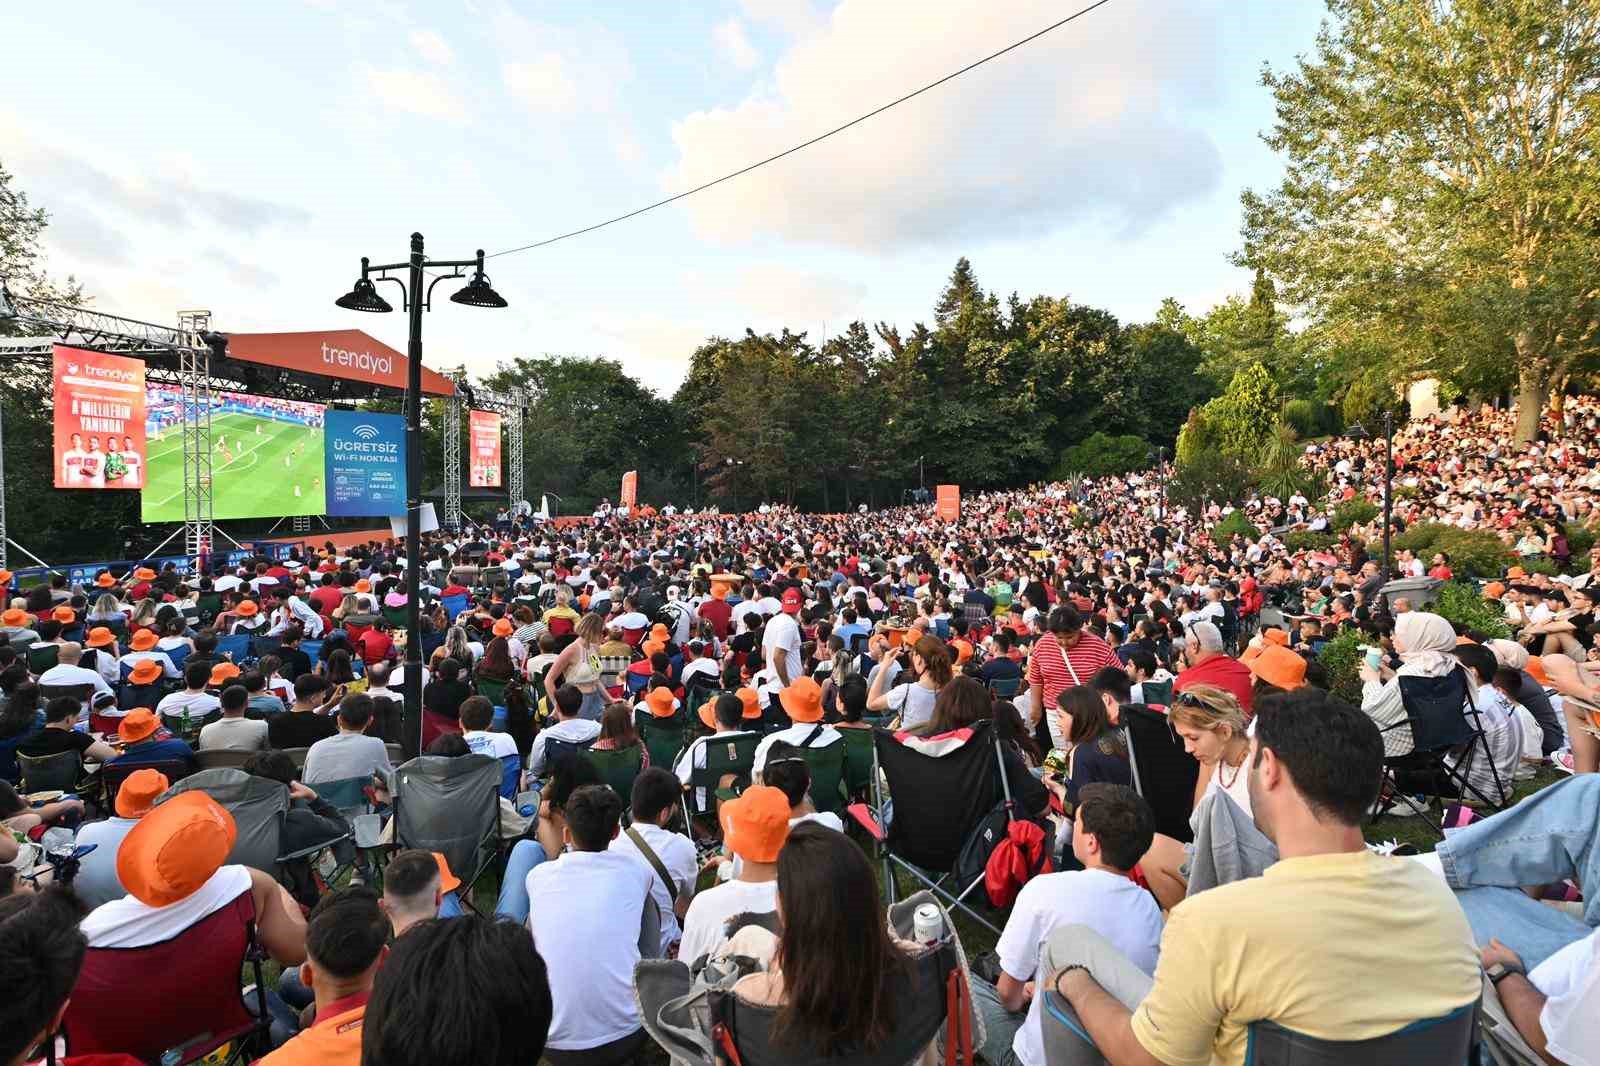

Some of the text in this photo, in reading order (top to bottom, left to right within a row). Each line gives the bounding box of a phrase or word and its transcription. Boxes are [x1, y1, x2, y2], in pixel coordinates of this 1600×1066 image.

[321, 342, 392, 375] trendyol
[84, 364, 137, 381] trendyol
[334, 439, 398, 453] ÜCRETSİZ
[360, 455, 397, 463] NOKTASI
